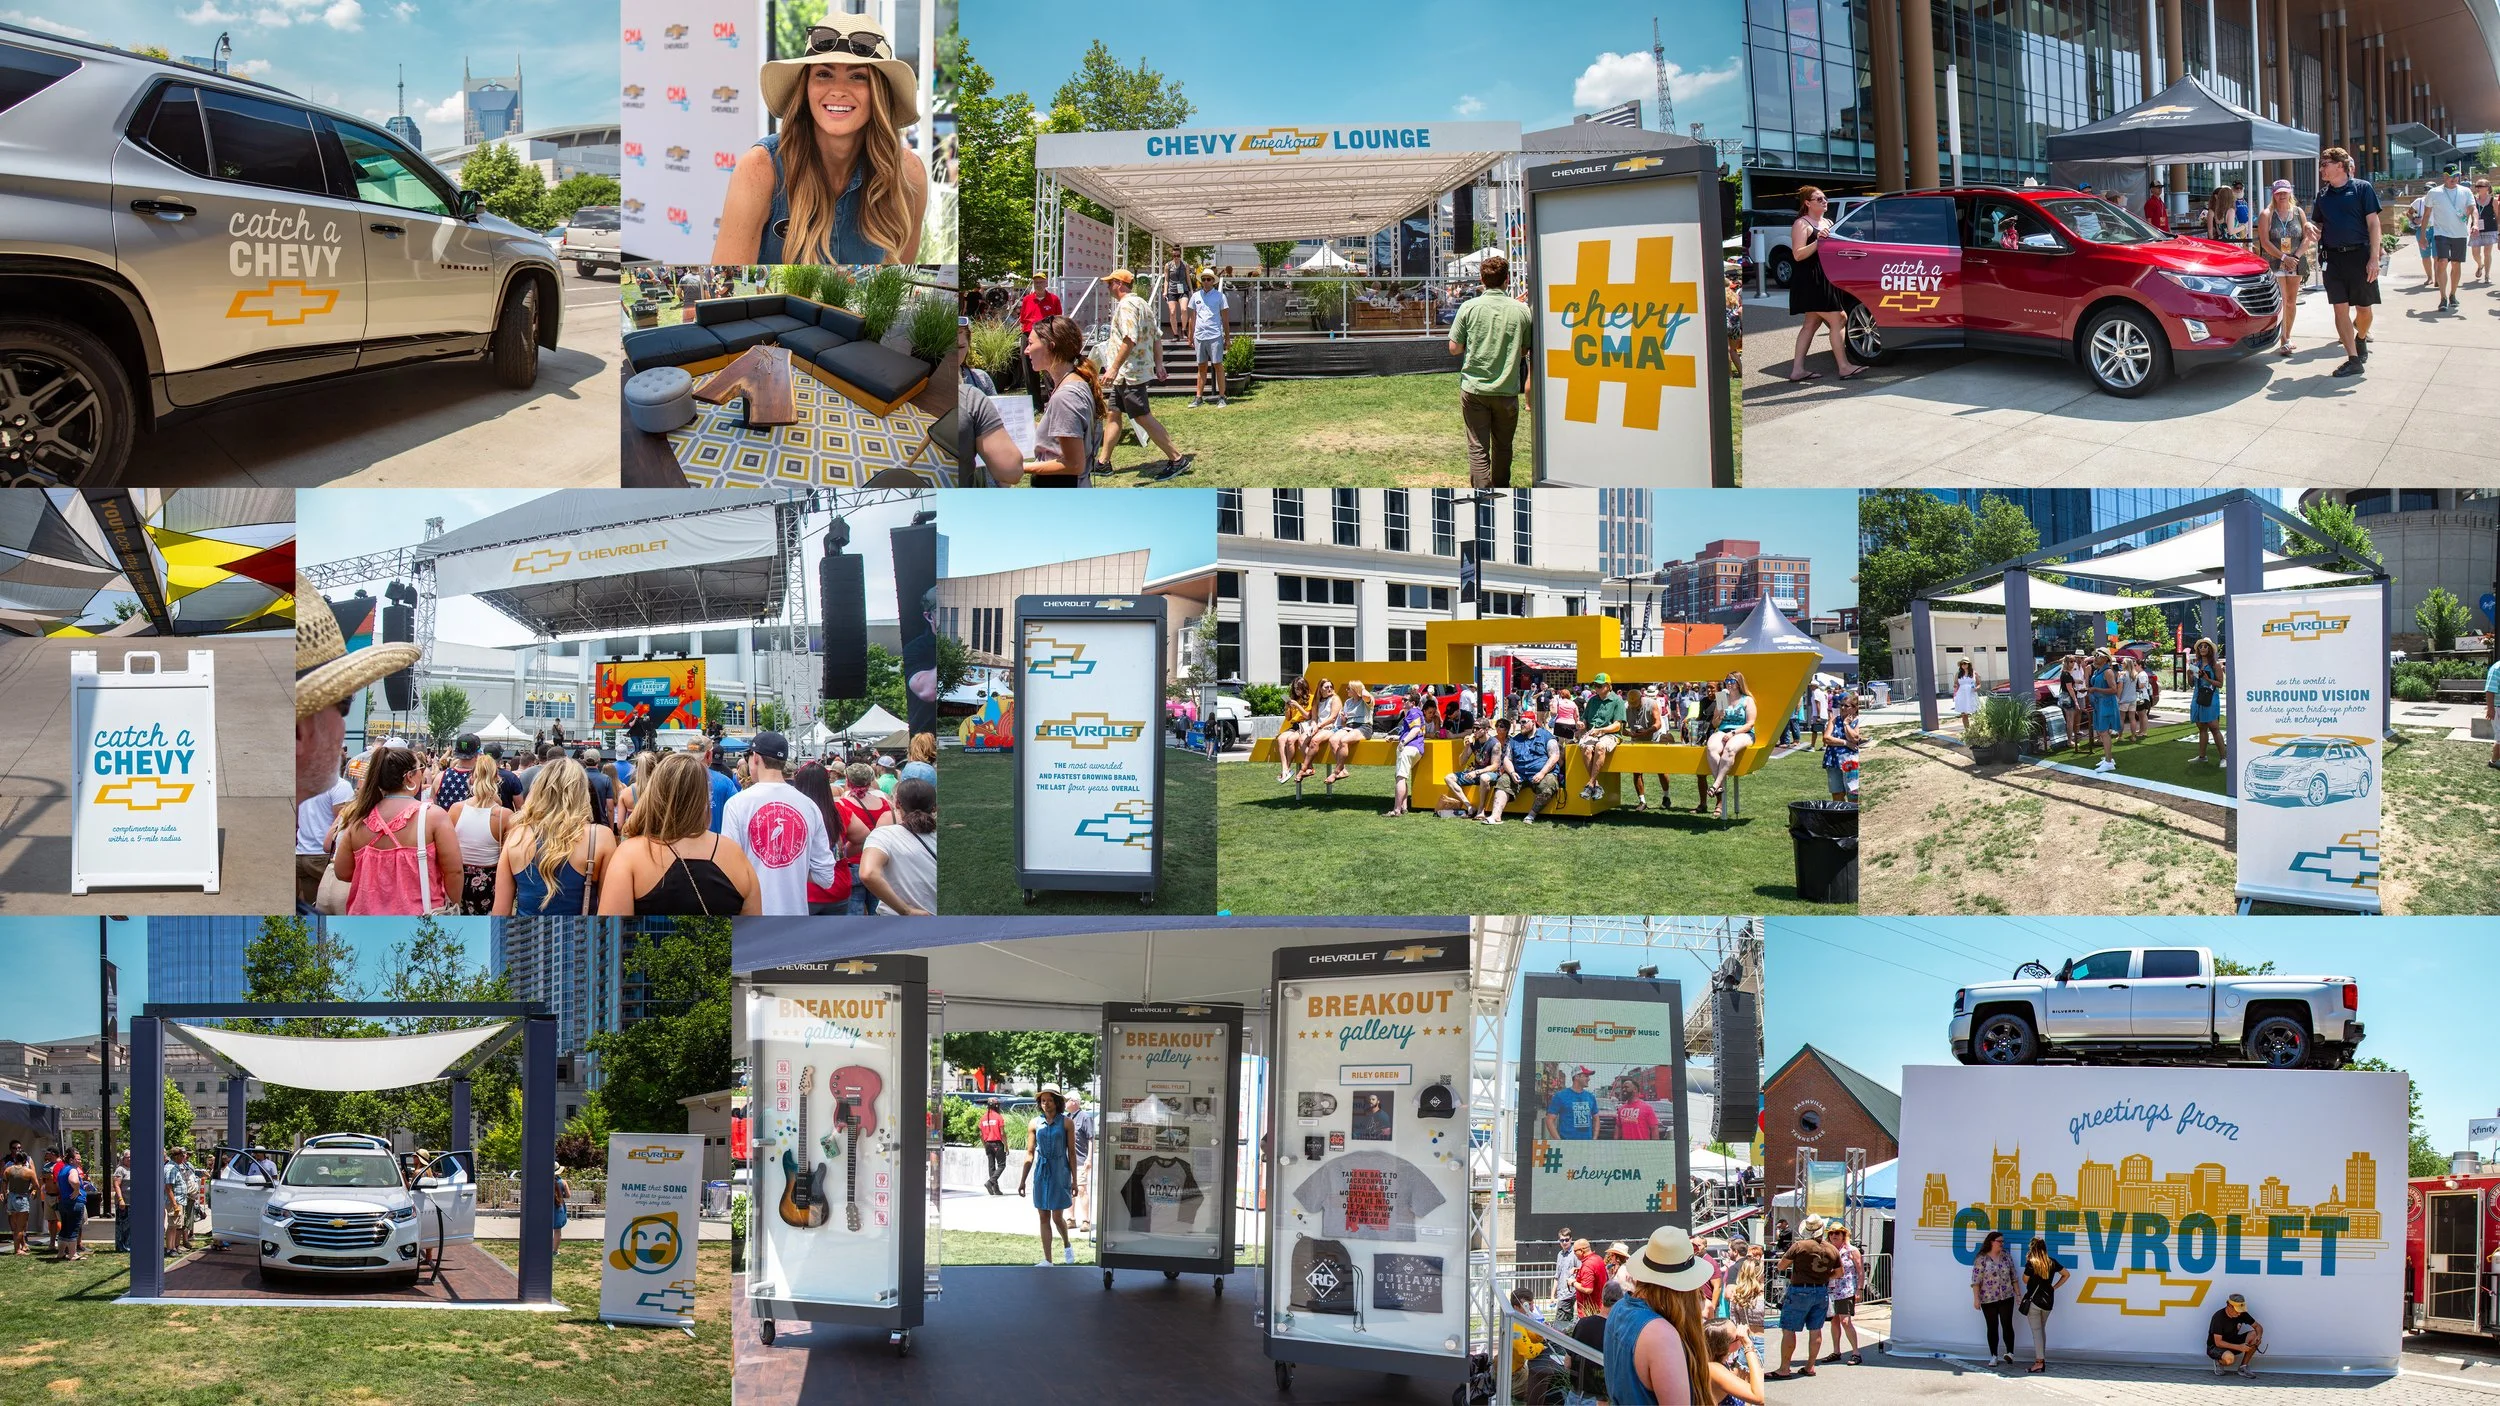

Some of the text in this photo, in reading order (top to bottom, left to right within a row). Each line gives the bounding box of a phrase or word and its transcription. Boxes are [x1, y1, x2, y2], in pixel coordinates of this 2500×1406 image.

[624, 29, 641, 42] CMA
[713, 22, 736, 38] CMA
[666, 86, 687, 102] CMA
[2120, 115, 2190, 126] CHEVROLET
[625, 142, 643, 156] CMA
[1146, 128, 1431, 157] CHEVY breakout LOUNGE
[714, 151, 736, 168] CMA
[1552, 165, 1607, 178] CHEVROLET
[667, 207, 688, 224] CMA
[229, 208, 341, 243] catch a
[229, 241, 342, 277] CHEVY
[440, 263, 490, 272] TRAVERSE
[1881, 260, 1943, 276] catch a
[1880, 276, 1942, 292] CHEVY
[1561, 289, 1691, 350] chevy
[1574, 333, 1666, 371] CMA
[578, 539, 668, 561] CHEVROLET
[2262, 620, 2350, 632] CHEVROLET
[2303, 676, 2326, 685] world
[2246, 689, 2370, 702] SURROUND VISION
[2286, 707, 2304, 715] your
[2343, 704, 2366, 715] photo
[94, 723, 195, 747] catch a
[1035, 725, 1145, 737] CHEVROLET
[94, 750, 195, 775] CHEVY
[1089, 762, 1123, 770] awarded
[1068, 784, 1085, 793] four
[1087, 785, 1109, 793] years
[112, 825, 159, 834] complimentary
[1309, 952, 1378, 964] CHEVROLET
[776, 963, 829, 971] CHEVROLET
[779, 1000, 887, 1018] BREAKOUT
[1308, 990, 1453, 1017] BREAKOUT
[804, 1020, 861, 1048] gallery
[1339, 1019, 1415, 1051] gallery
[1547, 1026, 1580, 1034] OFFICIAL
[1126, 1032, 1214, 1048] BREAKOUT
[1146, 1049, 1192, 1069] gallery
[1374, 1071, 1399, 1079] GREEN
[1793, 1099, 1827, 1112] NASHVILLE
[2068, 1098, 2240, 1145] greetings from
[1791, 1129, 1826, 1143] TENNESSEE
[2471, 1125, 2498, 1136] xfinity
[1567, 1166, 1642, 1186] #chevyCMA
[621, 1183, 647, 1191] NAME
[663, 1185, 687, 1193] SONG
[1148, 1184, 1180, 1197] CRAZY
[1951, 1206, 2350, 1277] CHEVROLET
[1312, 1273, 1333, 1286] RG
[1376, 1273, 1440, 1286] OUTLAWS
